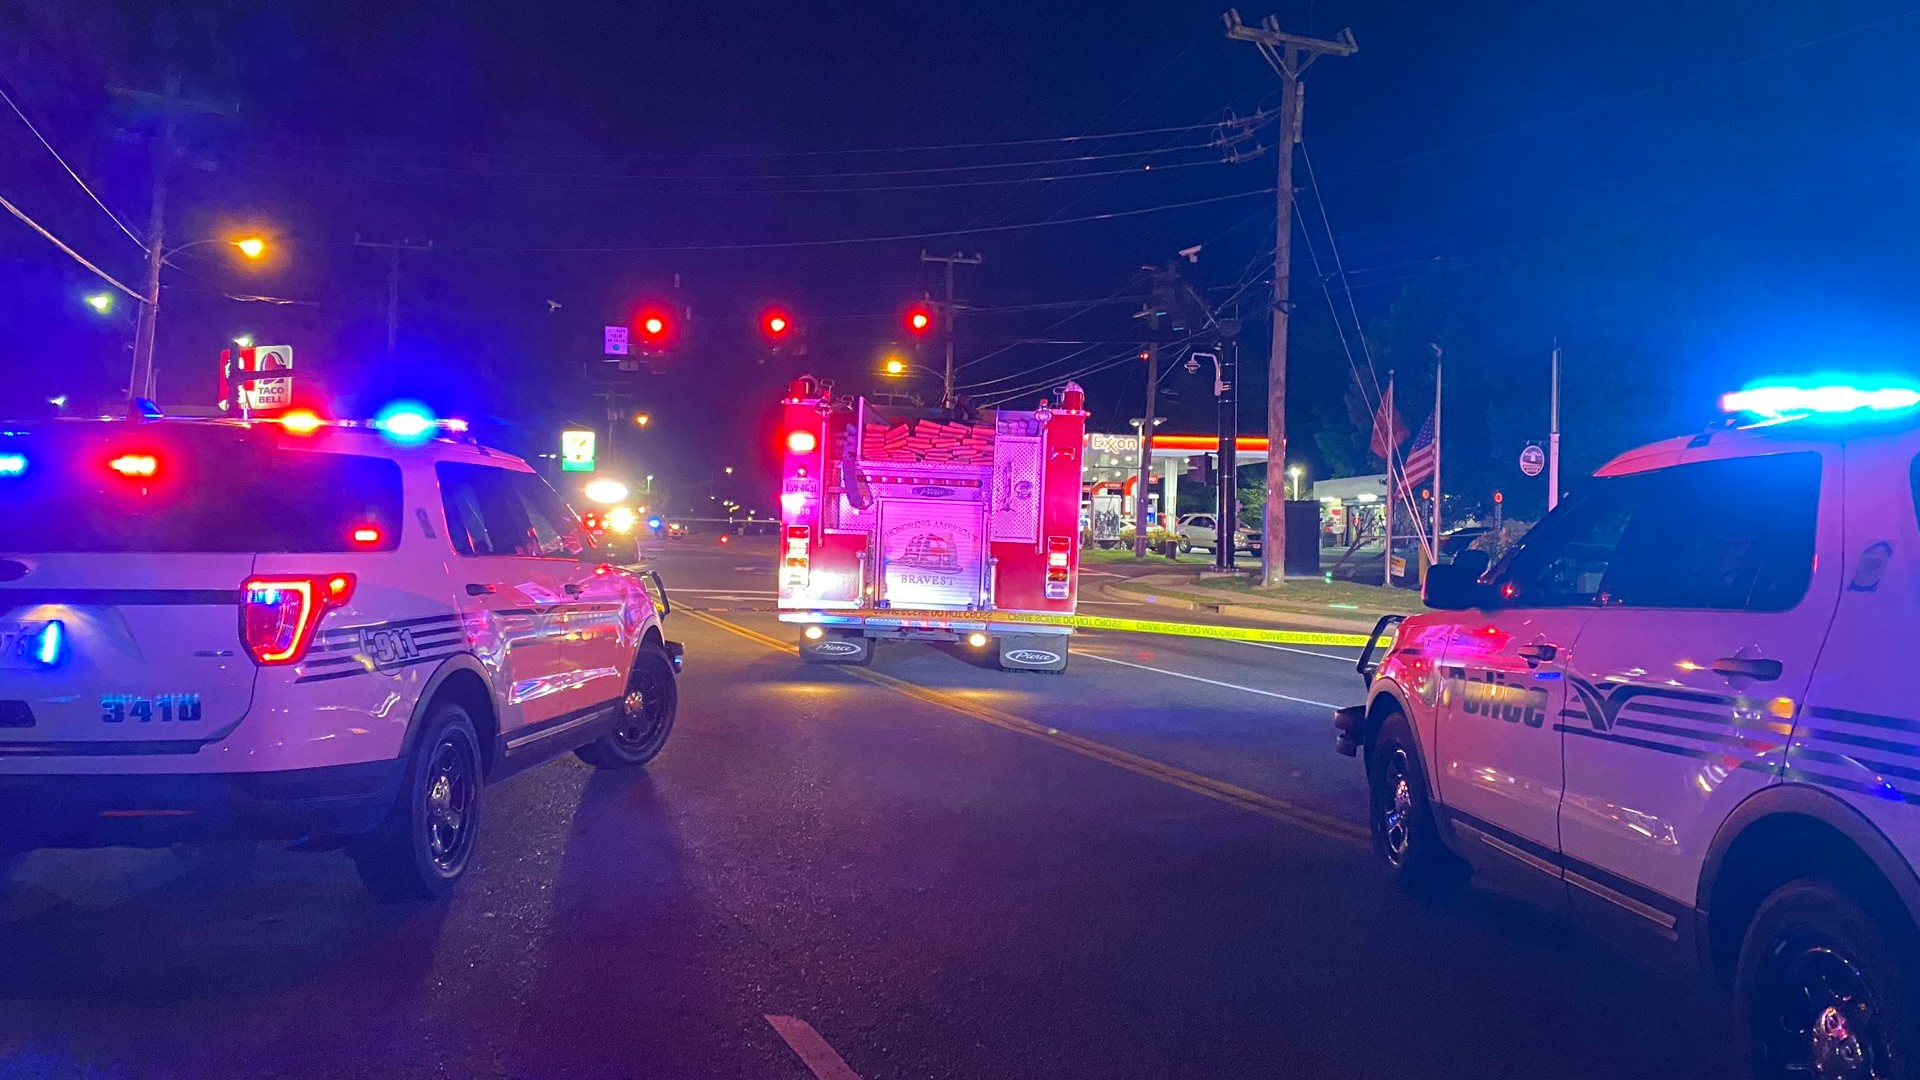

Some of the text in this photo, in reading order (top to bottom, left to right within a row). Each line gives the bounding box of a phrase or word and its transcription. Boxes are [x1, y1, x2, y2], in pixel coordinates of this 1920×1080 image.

[257, 386, 285, 394] TACO
[258, 395, 283, 403] BELL
[1092, 434, 1138, 454] Exxon
[883, 520, 931, 538] HONORING
[901, 574, 956, 586] BRAVEST
[815, 643, 851, 652] Pierce
[1015, 651, 1051, 661] Pierce
[1444, 667, 1549, 729] Police
[101, 696, 202, 723] 3410
